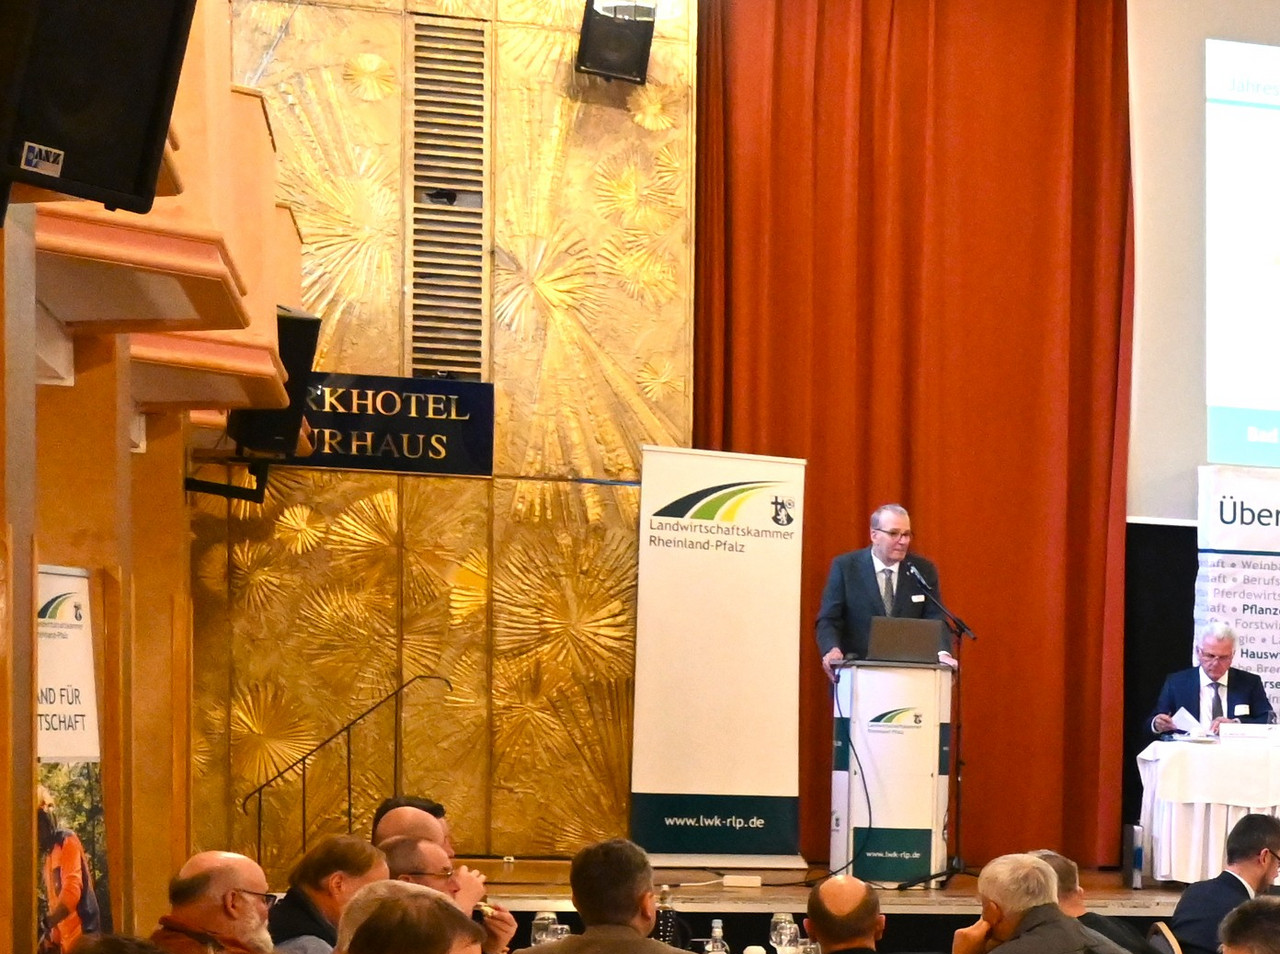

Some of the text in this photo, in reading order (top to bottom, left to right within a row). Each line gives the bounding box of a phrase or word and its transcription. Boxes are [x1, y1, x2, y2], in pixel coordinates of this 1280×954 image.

[1247, 425, 1277, 444] Bad
[650, 518, 795, 540] Landwirtschaftskammer
[649, 535, 745, 553] Rheinland-Pfalz
[60, 684, 82, 706] FÜR
[664, 815, 765, 831] www.lwk-rlp.de
